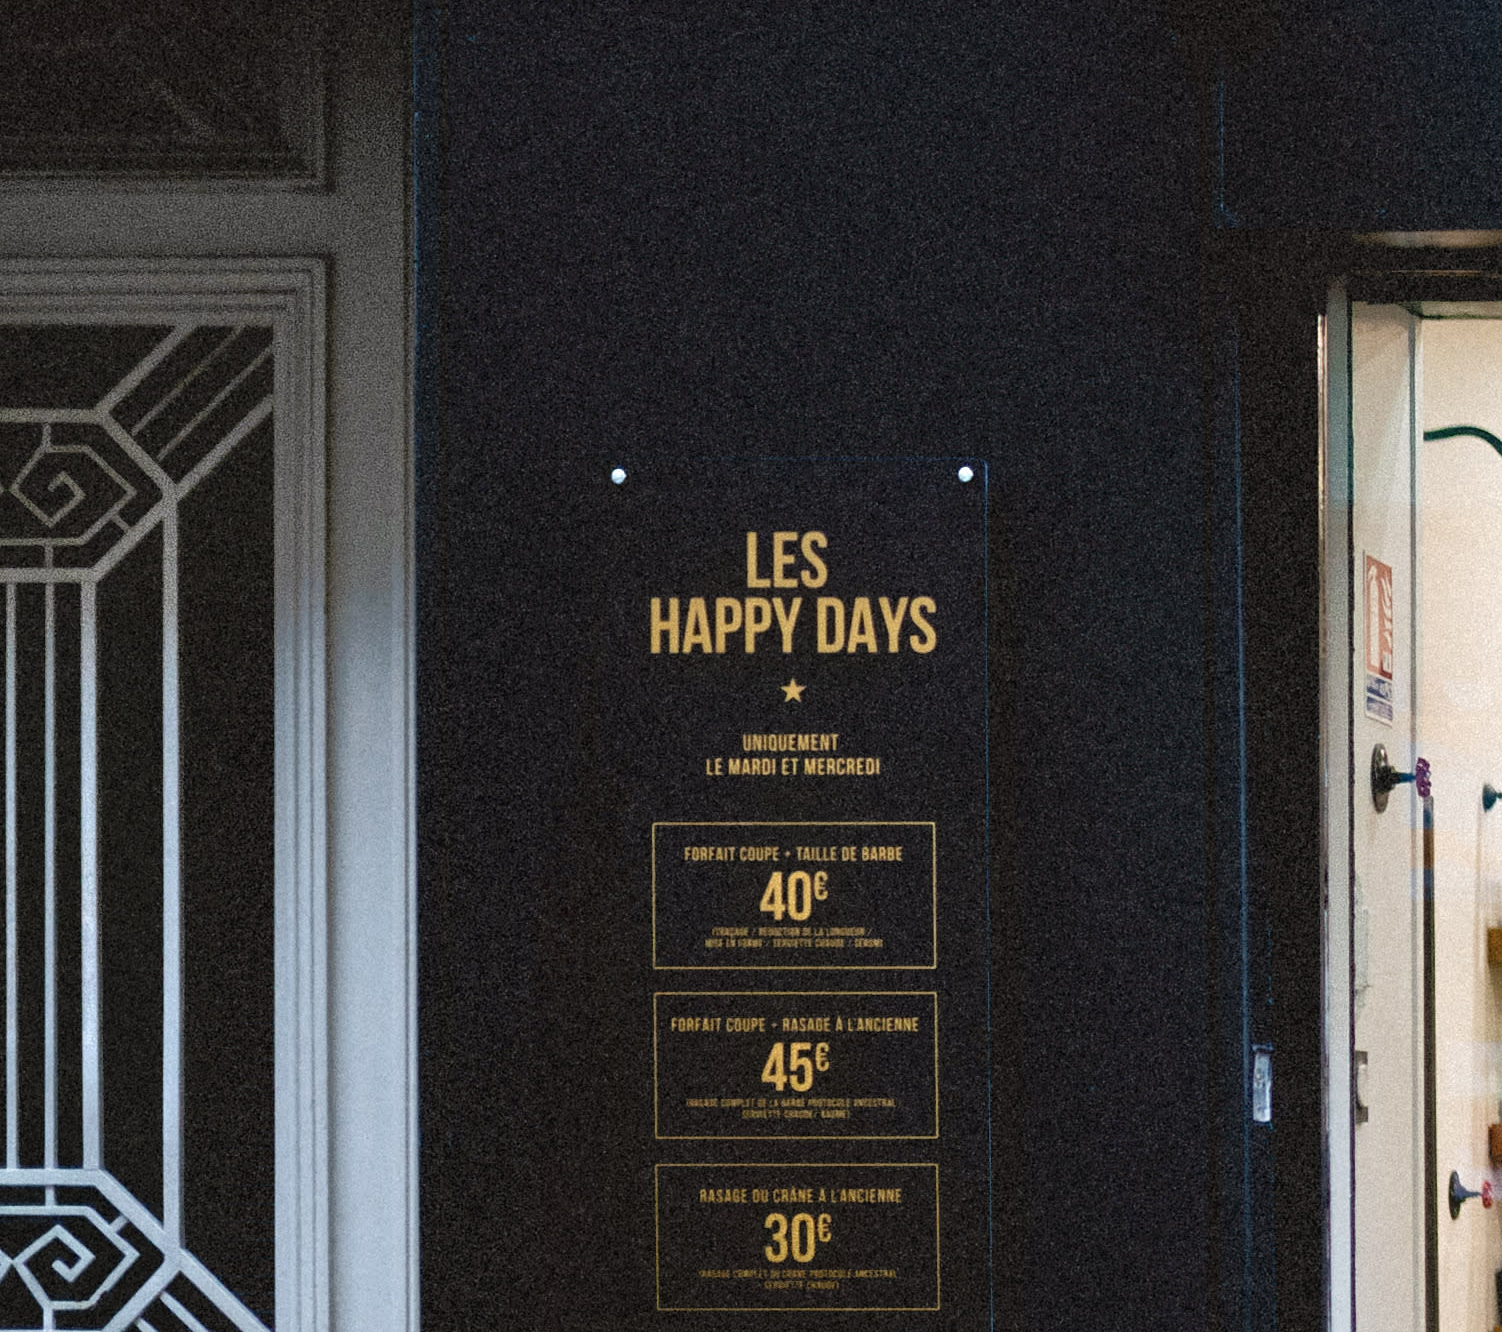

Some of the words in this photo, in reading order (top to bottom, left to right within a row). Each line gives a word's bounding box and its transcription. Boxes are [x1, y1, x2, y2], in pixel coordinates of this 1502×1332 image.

[746, 530, 828, 589] LES
[650, 596, 803, 654] HAPPY
[816, 596, 937, 654] DAYS
[742, 733, 839, 752] UNIQUEMENT
[705, 757, 722, 776] LE
[728, 757, 777, 776] MARDI
[781, 757, 799, 776] ET
[803, 757, 881, 776] MERCREDI
[684, 846, 736, 862] FORFAIT
[739, 846, 779, 862] COUPE
[796, 845, 837, 862] TAILLE
[841, 845, 857, 862] DE
[861, 845, 903, 862] BARBE
[759, 870, 829, 921] 40€
[670, 1017, 722, 1033] FORFAIT
[725, 1017, 765, 1033] COUPE
[781, 1016, 830, 1033] RASAGE
[835, 1015, 844, 1032] À
[847, 1016, 919, 1033] L'ANCIENNE
[761, 1041, 830, 1092] 45€
[699, 1188, 747, 1204] RASAGE
[751, 1188, 769, 1203] DU
[772, 1186, 813, 1204] CRÂNE
[830, 1187, 902, 1204] L'ANCIENNE
[764, 1212, 832, 1263] 30€
